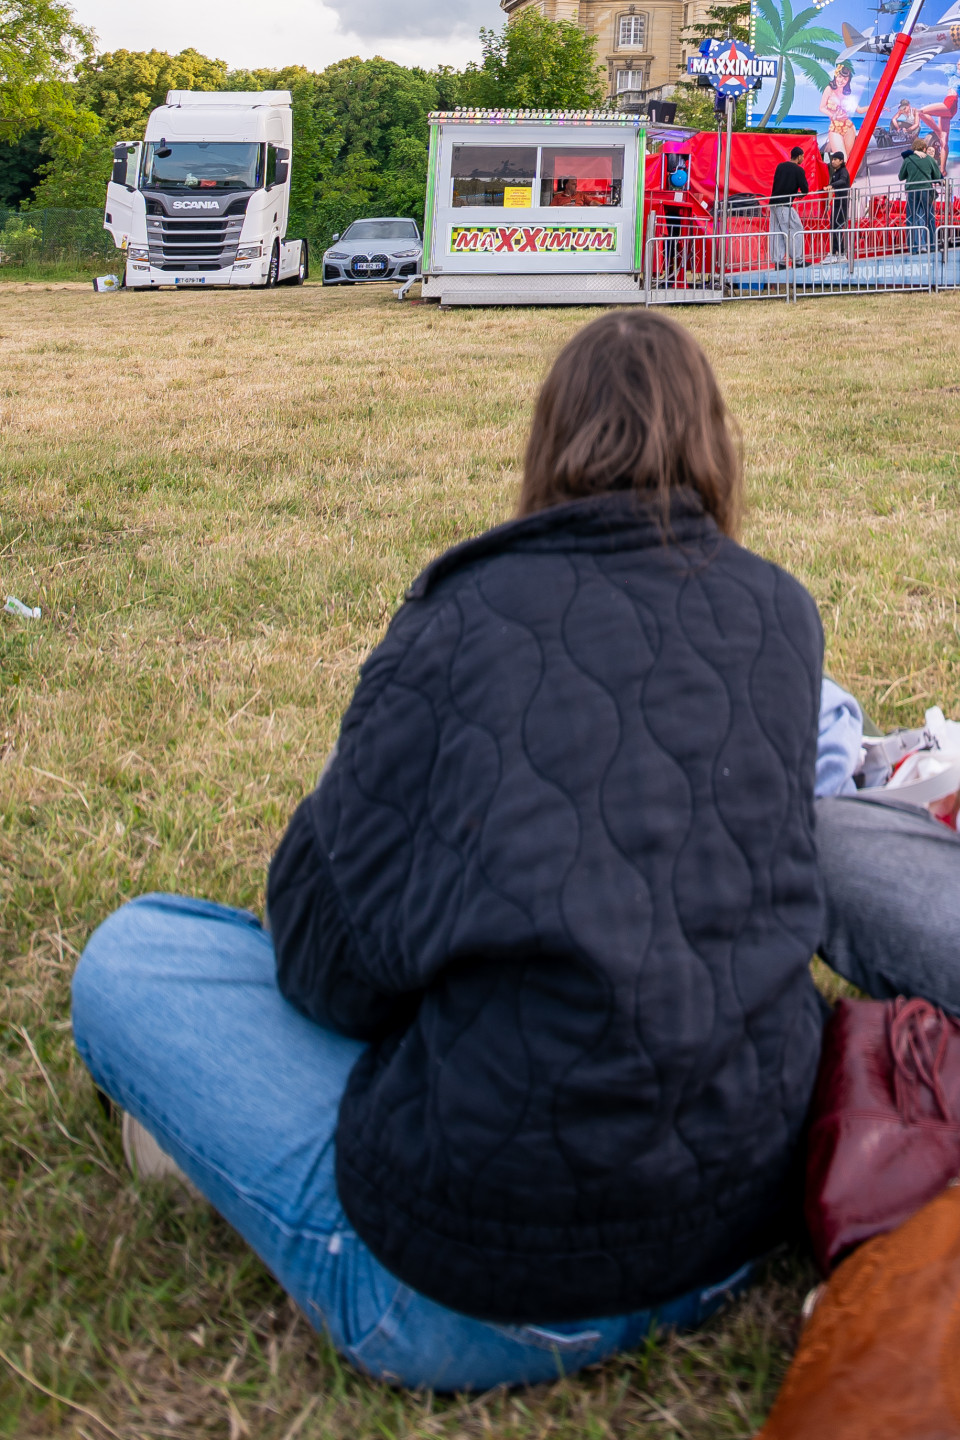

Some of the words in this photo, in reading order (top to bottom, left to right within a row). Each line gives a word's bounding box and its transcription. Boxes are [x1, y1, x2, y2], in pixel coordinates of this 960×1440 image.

[692, 58, 775, 76] MAXXIMUM
[172, 200, 220, 209] SCANIA
[455, 227, 615, 252] MAXXIMUM
[810, 263, 933, 281] EMBARQUEMENT
